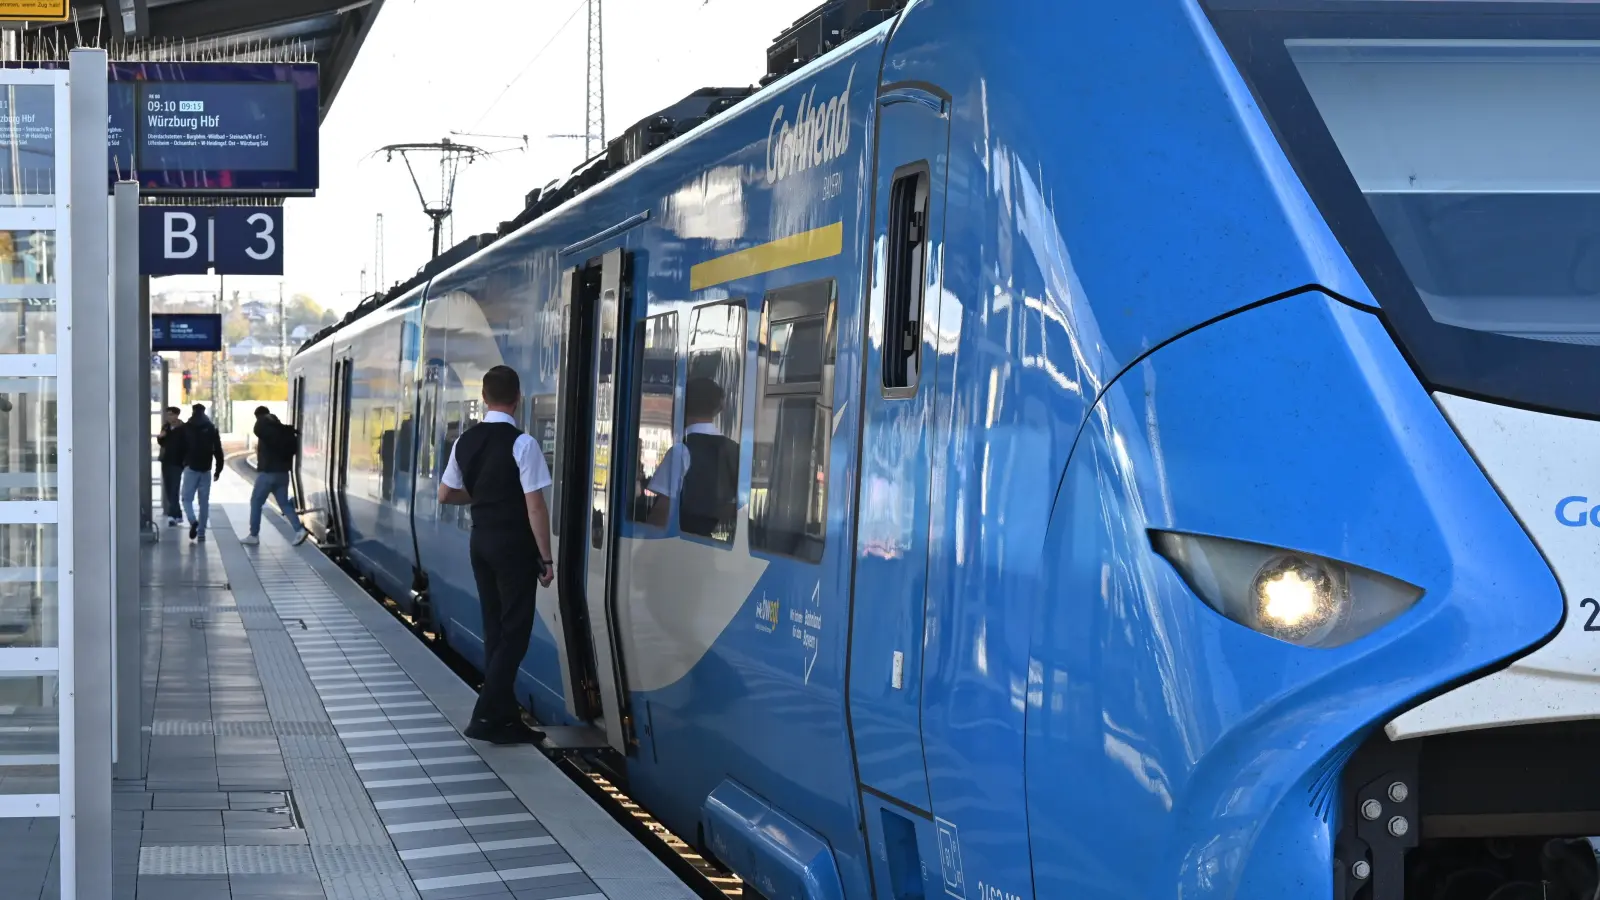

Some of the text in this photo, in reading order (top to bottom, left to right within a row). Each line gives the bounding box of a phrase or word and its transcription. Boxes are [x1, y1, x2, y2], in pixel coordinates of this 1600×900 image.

[147, 101, 202, 111] 09:10 09:15
[21, 114, 35, 123] Hbf
[147, 115, 220, 130] Würzburg Hbf
[164, 211, 276, 260] B 3
[1579, 598, 1600, 632] 2
